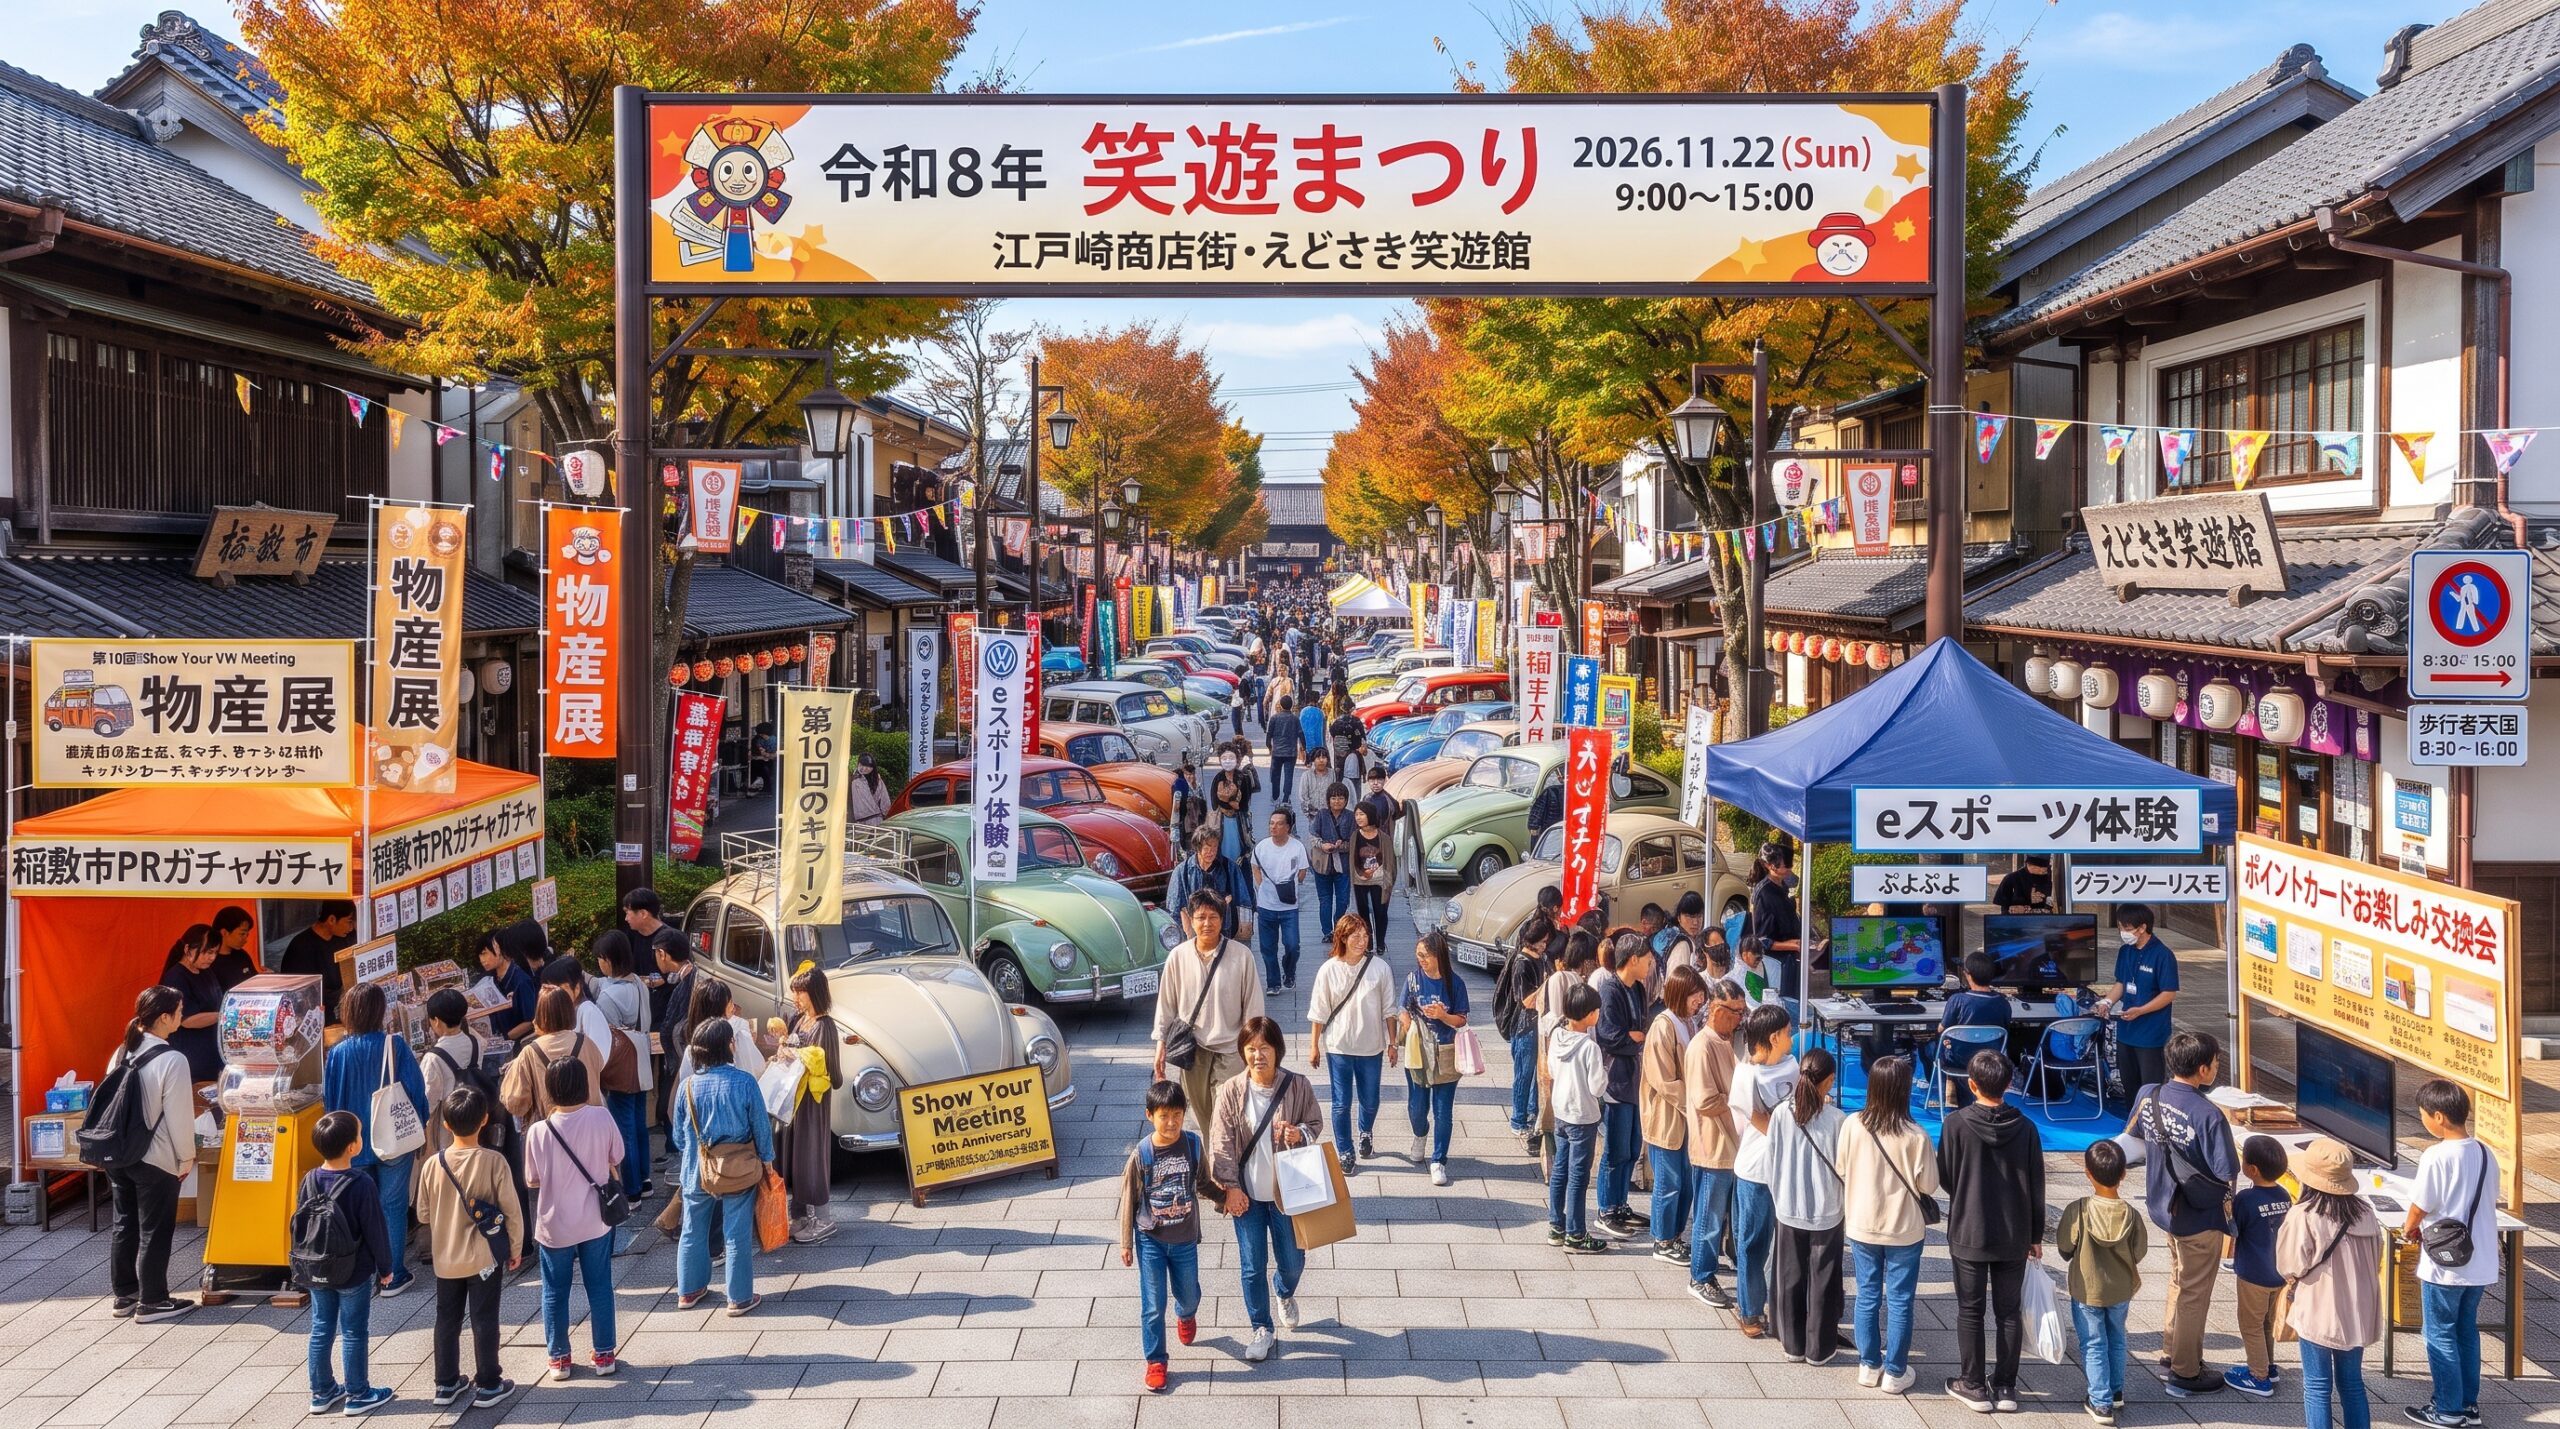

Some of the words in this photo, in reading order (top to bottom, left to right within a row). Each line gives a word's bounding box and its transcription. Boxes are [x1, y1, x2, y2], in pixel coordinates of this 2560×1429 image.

[820, 143, 1047, 203] 令和8年
[1082, 121, 1538, 216] 笑遊まつり
[992, 231, 1532, 271] 江戸崎商店街・えどさき笑遊館
[2101, 514, 2264, 570] えどさき笑遊館
[143, 652, 178, 665] Show
[182, 652, 213, 665] Your
[216, 652, 237, 665] VW
[241, 652, 296, 667] Meeting
[387, 557, 443, 731] 物産展
[555, 574, 609, 745] 物産展
[2473, 654, 2516, 668] 15:00
[140, 674, 336, 735] 物産展
[2419, 714, 2518, 735] 歩行者天国
[983, 686, 1011, 849] eスポーツ体験
[797, 705, 833, 916] 第10回のキラーン
[1876, 794, 2180, 843] eスポーツ体験
[372, 802, 538, 885] 稲敷市PRガチャガチャ
[13, 846, 344, 887] 稲敷市PRガチャガチャ
[1878, 873, 1960, 895] ぷよぷよ
[2074, 872, 2221, 895] グランツーリスモ
[2245, 854, 2497, 965] ポイントカードお楽しみ交換会
[912, 1090, 973, 1115] Show
[979, 1078, 1033, 1102] Your
[932, 1105, 1027, 1137] Meeting
[932, 1139, 959, 1155] 10th
[962, 1127, 1032, 1149] Anniversary
